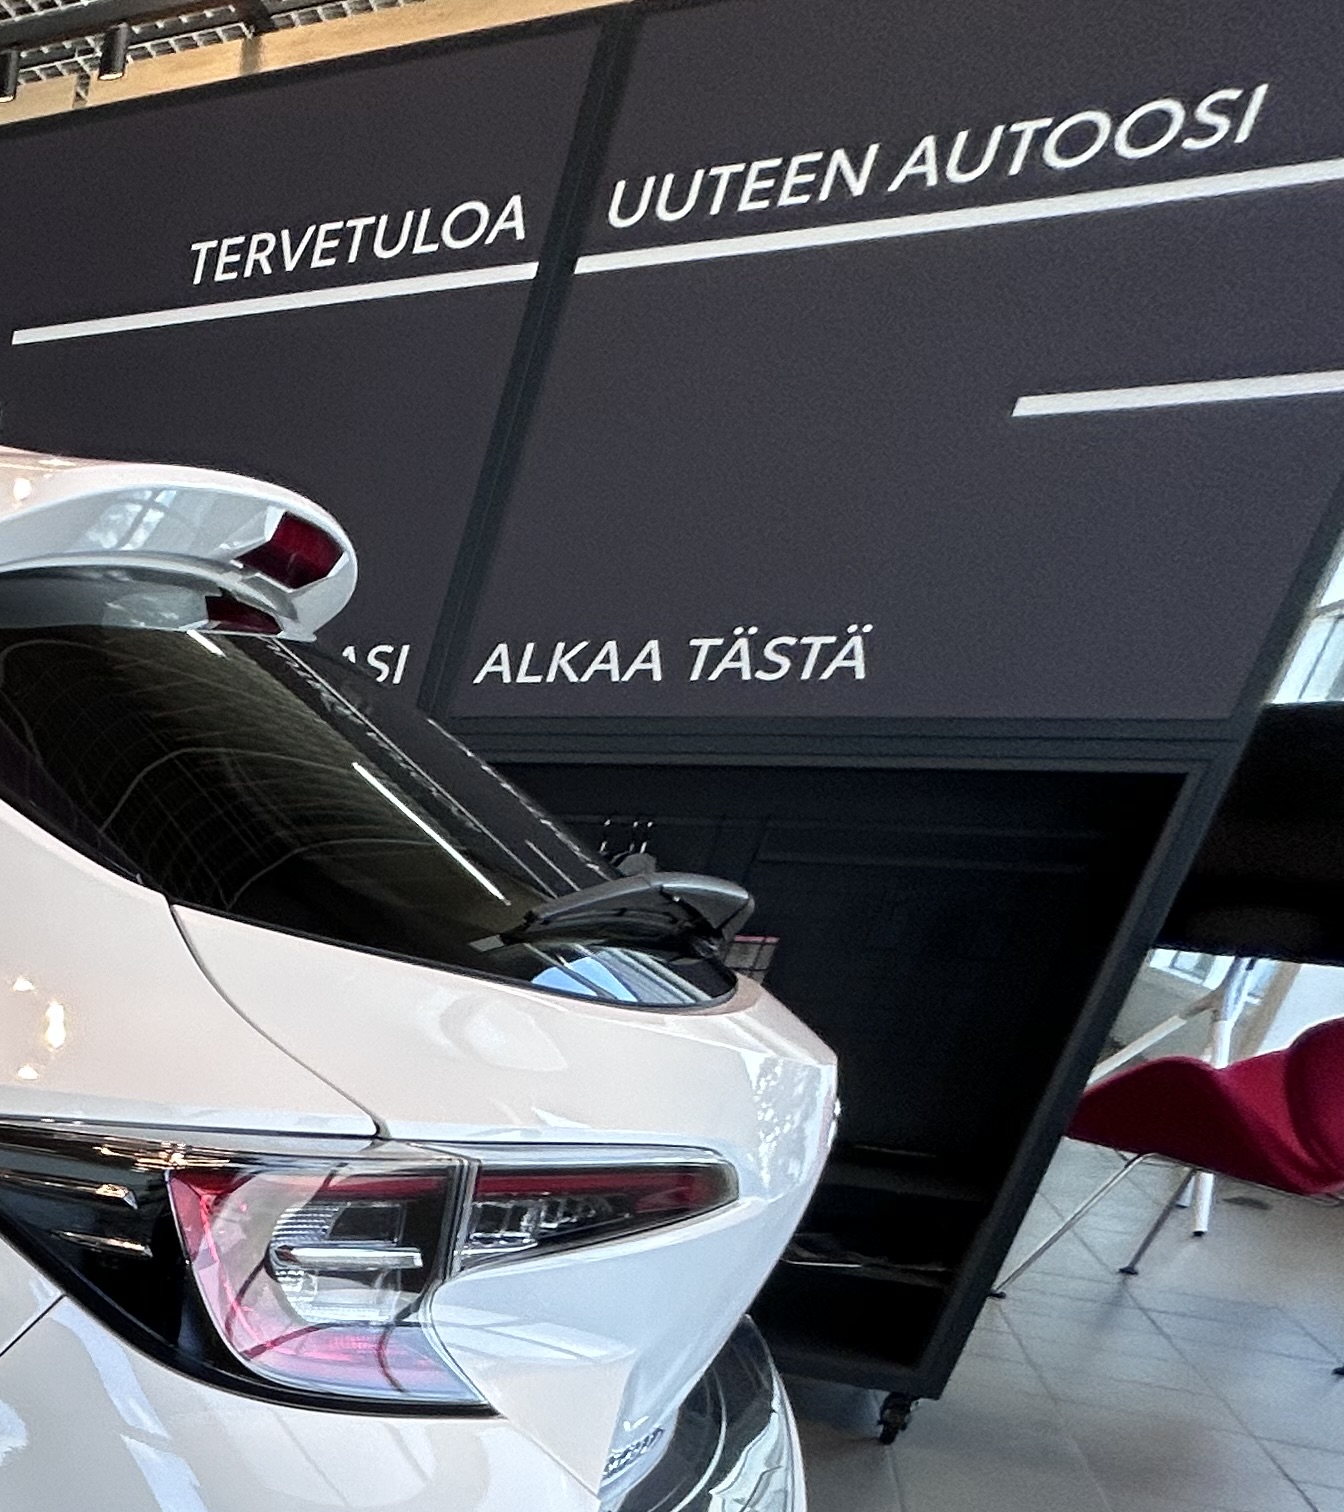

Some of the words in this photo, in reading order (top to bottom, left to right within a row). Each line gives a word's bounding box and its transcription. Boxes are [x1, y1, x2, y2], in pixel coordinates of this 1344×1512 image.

[191, 194, 526, 285] TERVETULOA
[608, 142, 880, 229] UUTEEN
[886, 83, 1269, 193] AUTOOSI
[472, 639, 663, 684] ALKAA
[689, 623, 874, 682] TÄSTÄ
